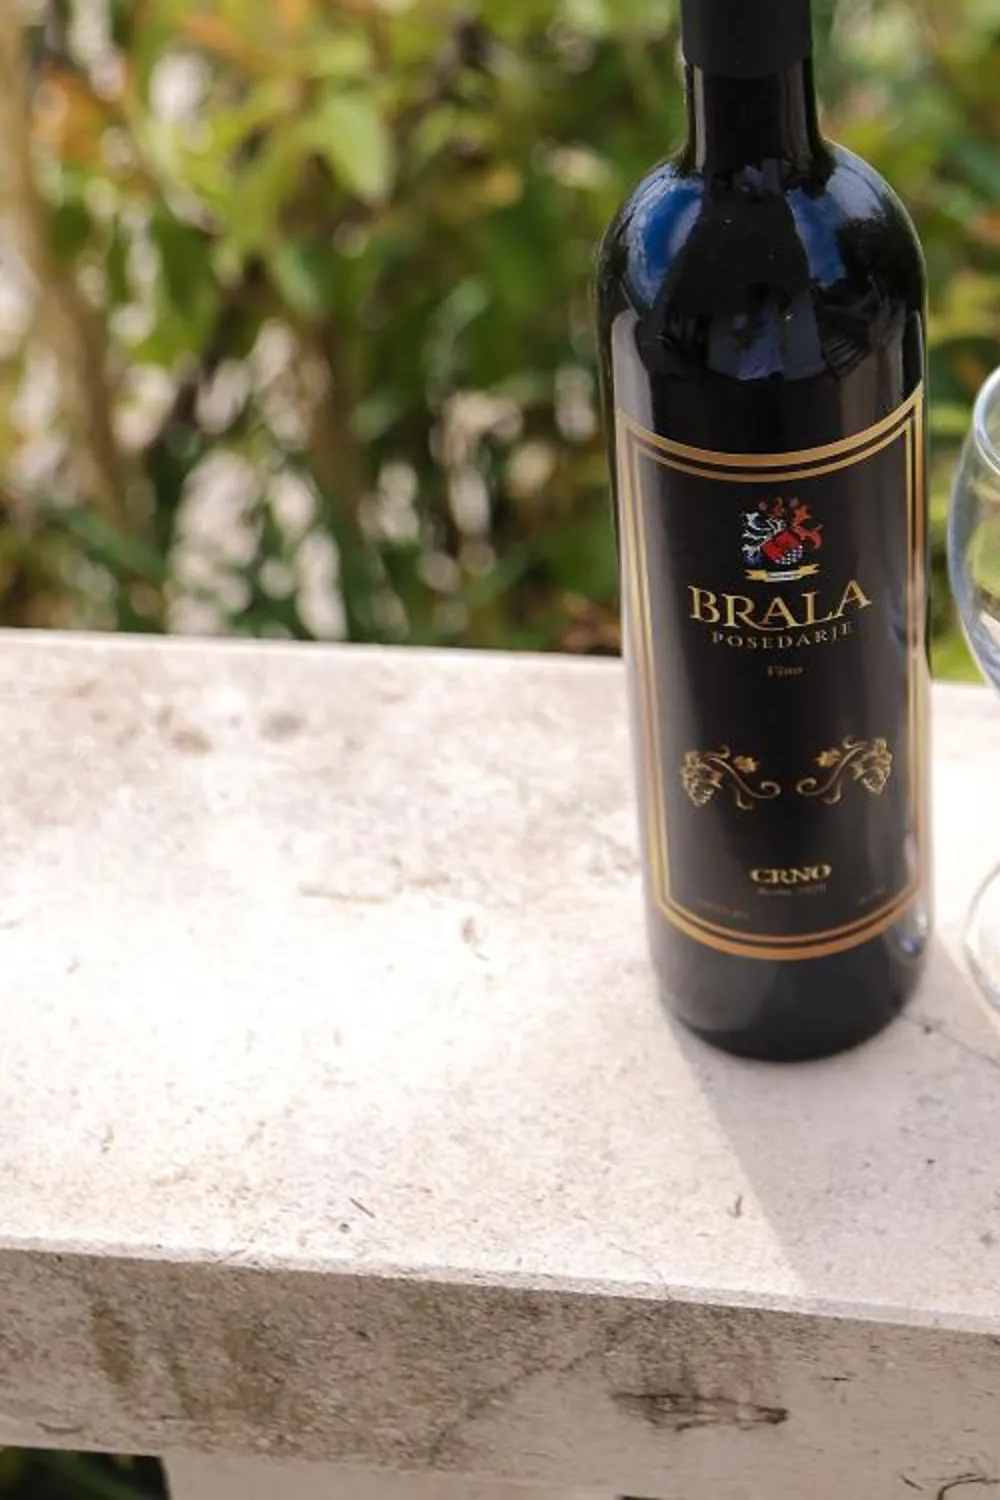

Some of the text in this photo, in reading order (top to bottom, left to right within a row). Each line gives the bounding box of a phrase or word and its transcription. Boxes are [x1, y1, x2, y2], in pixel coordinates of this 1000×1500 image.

[687, 579, 873, 631] BRALA
[711, 621, 854, 650] POSEDARJE
[750, 864, 832, 885] CRNO
